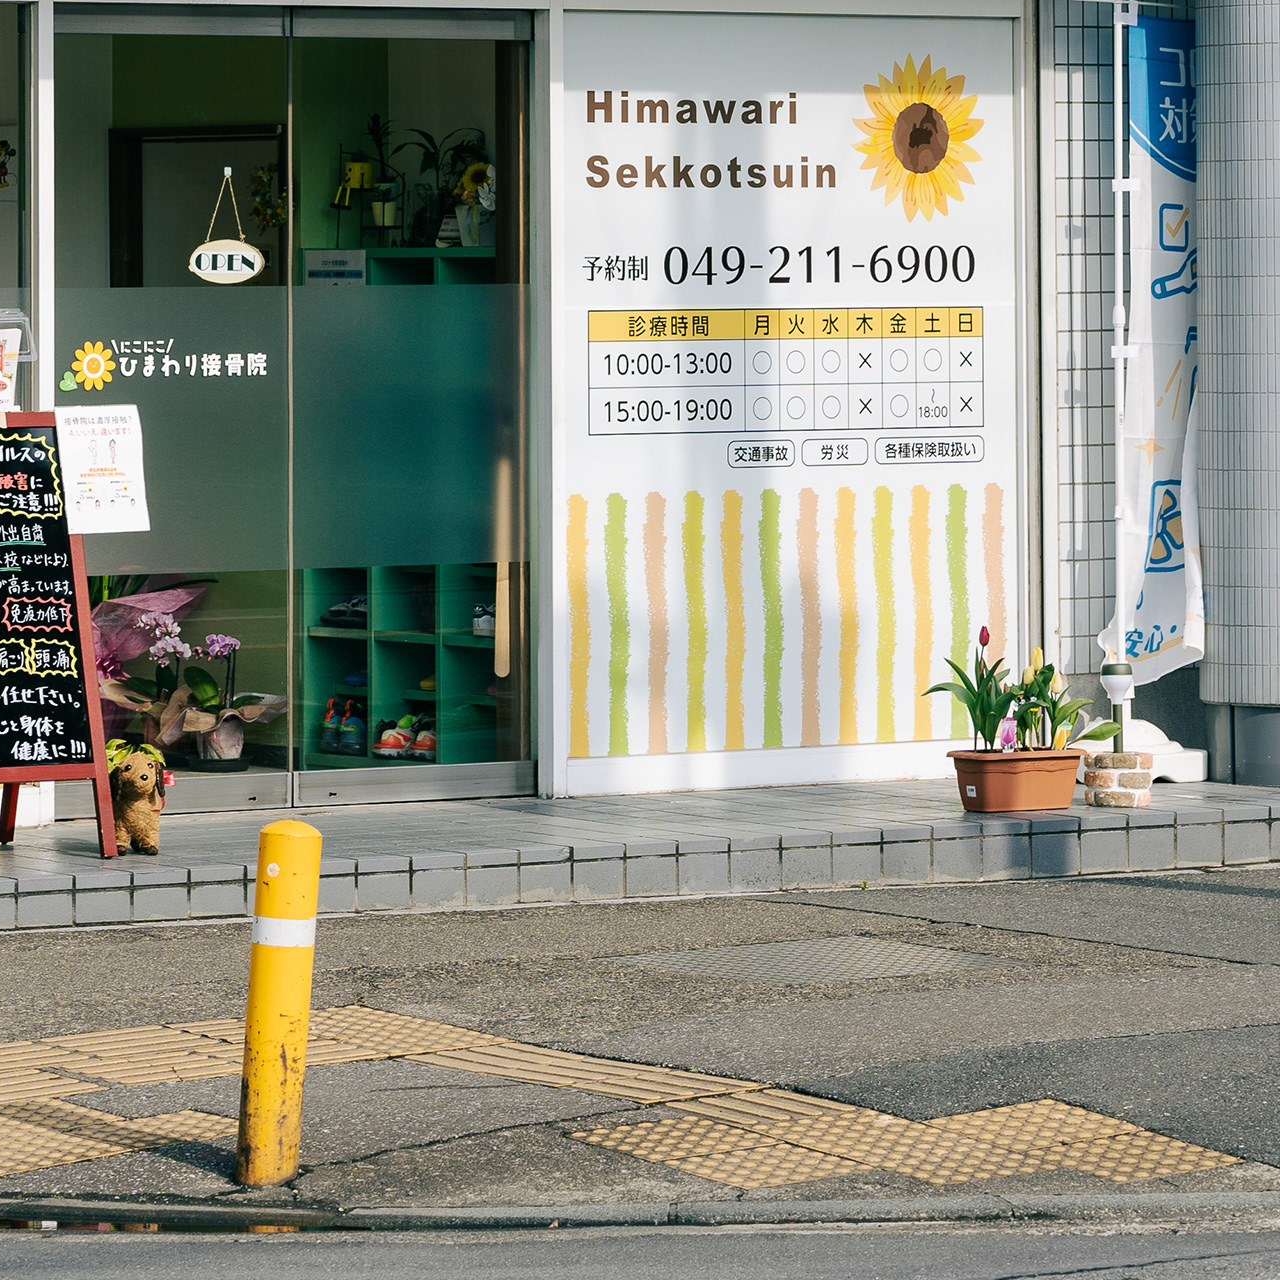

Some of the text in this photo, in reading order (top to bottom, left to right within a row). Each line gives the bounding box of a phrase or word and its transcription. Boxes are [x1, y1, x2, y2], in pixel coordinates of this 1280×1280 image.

[586, 90, 798, 124] Himawari
[586, 155, 837, 189] Sekkotsuin
[195, 252, 256, 272] OPEN
[581, 244, 976, 286] 予約制 049-211-6900
[627, 313, 973, 338] 診療時間 月 火 水 木 金 土 日
[120, 340, 166, 354] にこにこ
[118, 352, 268, 377] ひまわり接骨院
[603, 351, 733, 376] 10:00-13:00
[603, 398, 948, 423] 15:00-19:00 18:00
[733, 441, 977, 463] 交通事故 労災 各種保険取扱い
[10, 604, 68, 624] 免疫力低下
[35, 649, 70, 669] 頭痛
